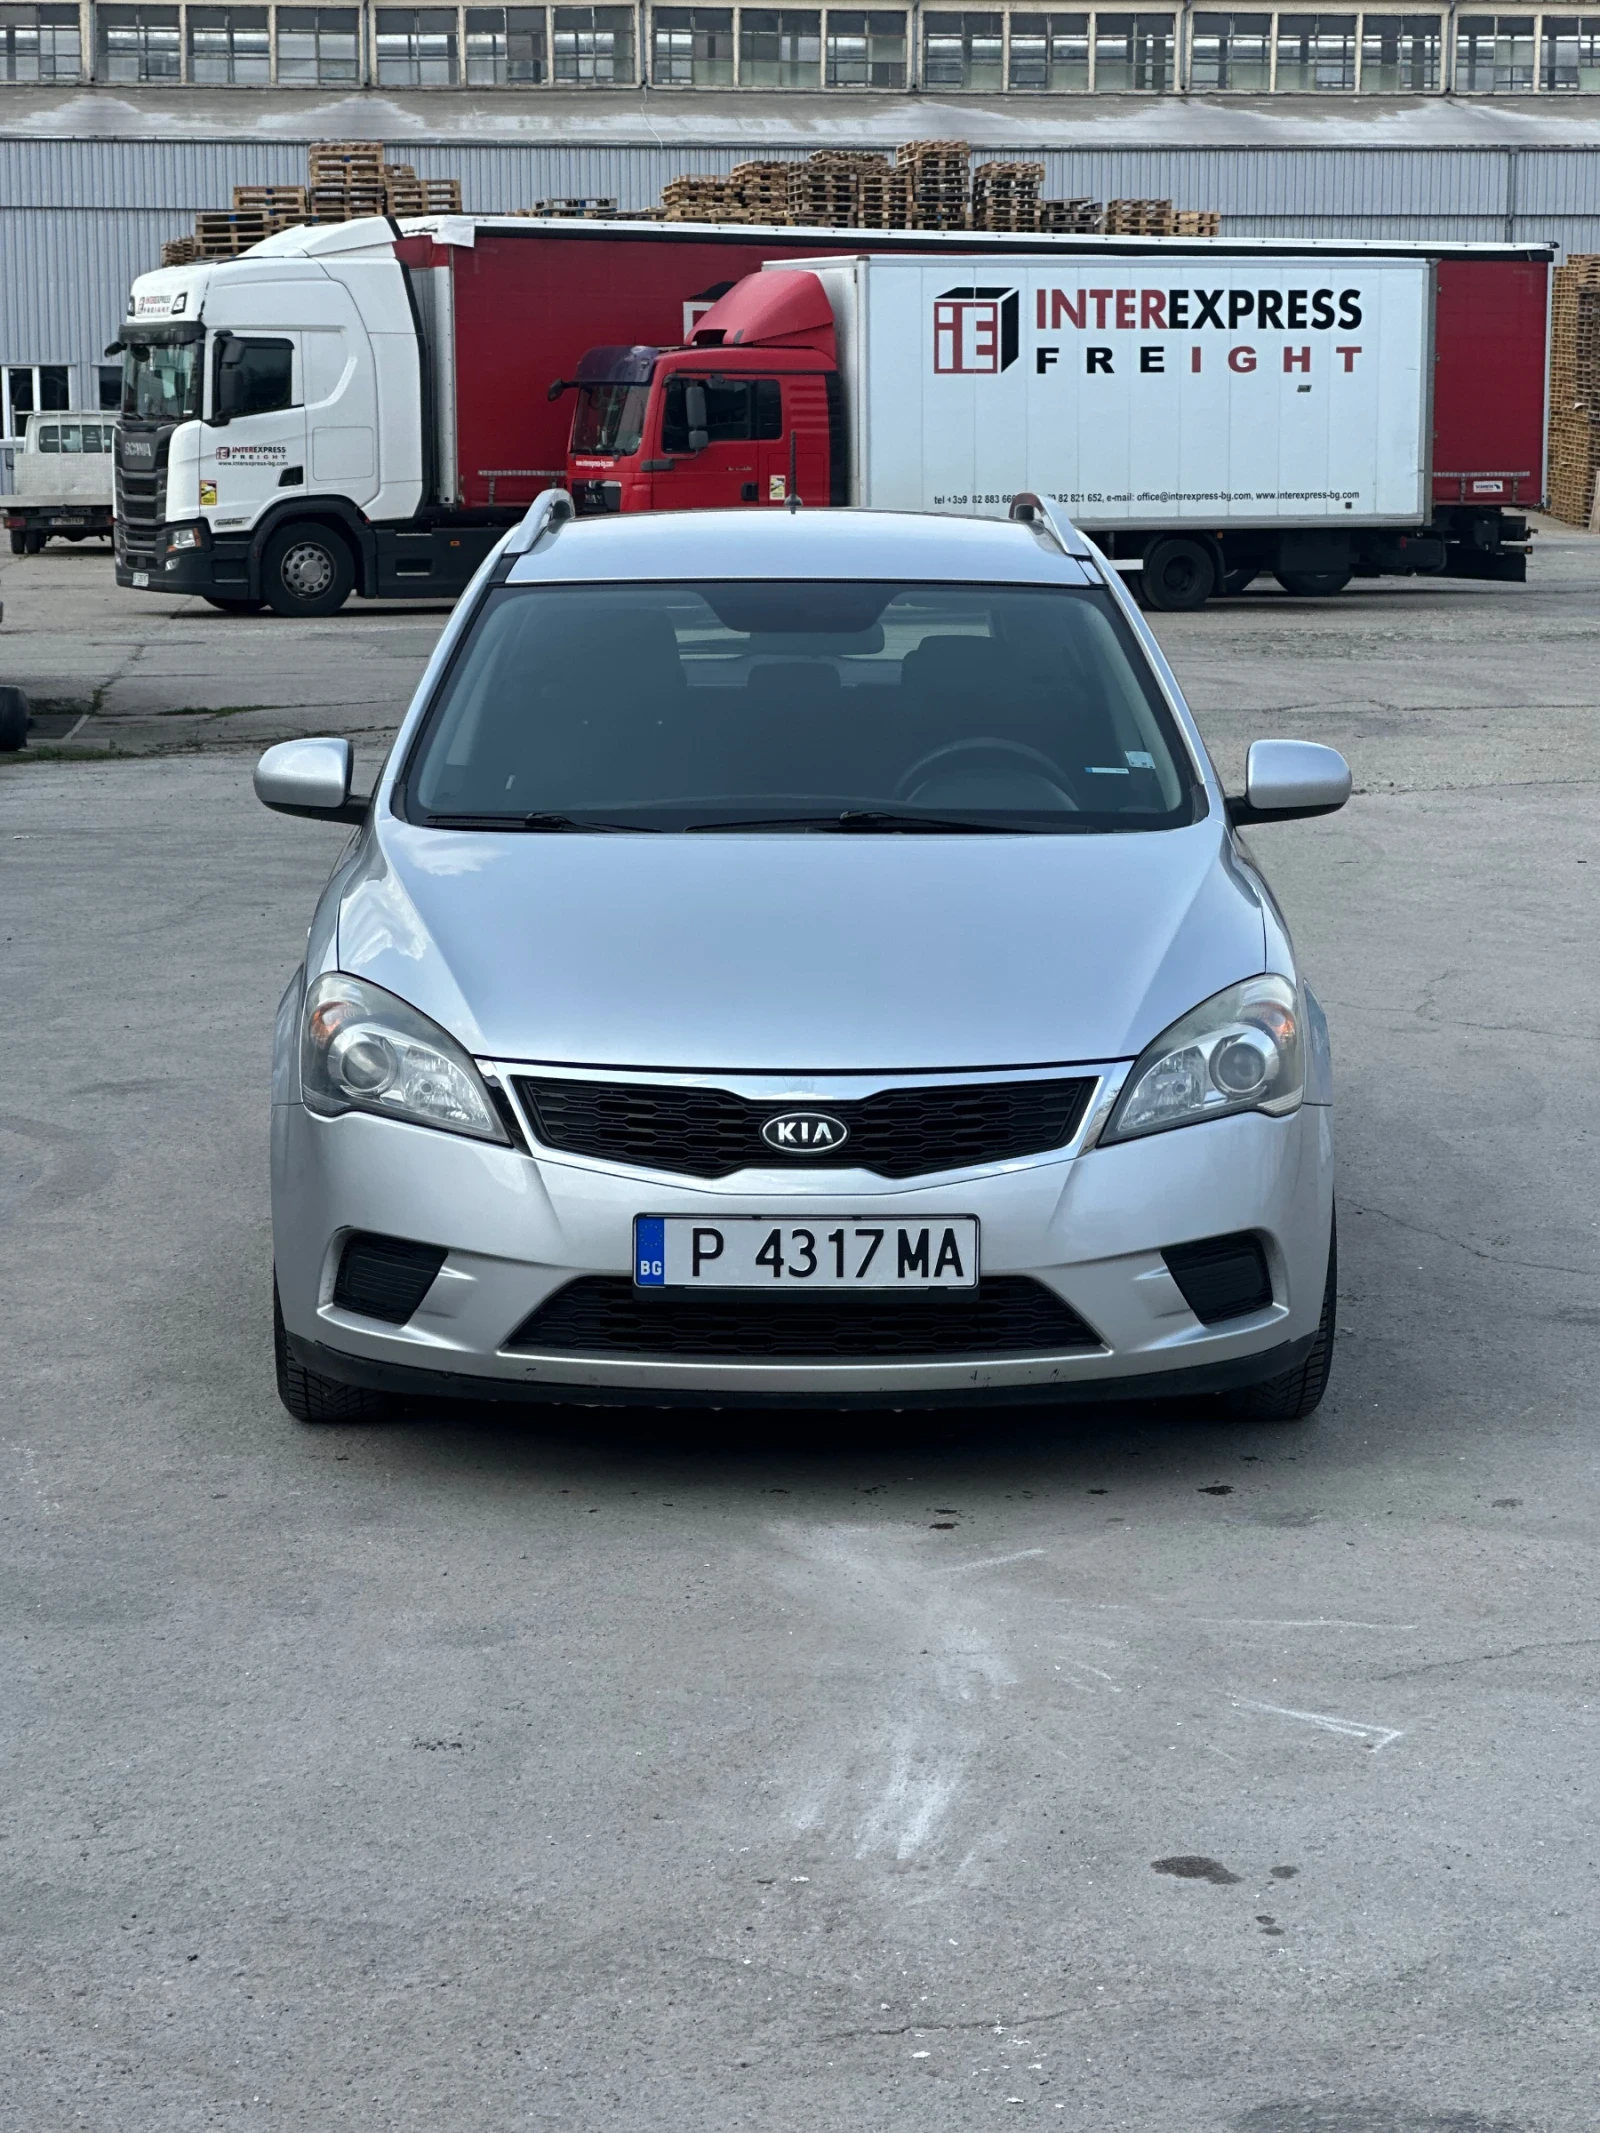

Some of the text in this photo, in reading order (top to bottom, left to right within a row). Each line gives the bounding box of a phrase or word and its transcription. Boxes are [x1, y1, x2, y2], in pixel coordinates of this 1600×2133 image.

[1036, 288, 1362, 330] INTEREXPRESS
[1036, 345, 1363, 374] FREIGHT
[934, 495, 945, 504] tel
[972, 495, 982, 503] 82
[1058, 494, 1068, 502] 82
[1071, 494, 1084, 502] 821
[1107, 493, 1134, 502] e-mail:
[1256, 491, 1360, 501] www.interexpress-bg.com
[777, 1122, 834, 1144] KIA
[692, 1227, 724, 1277] P
[640, 1260, 662, 1276] BG
